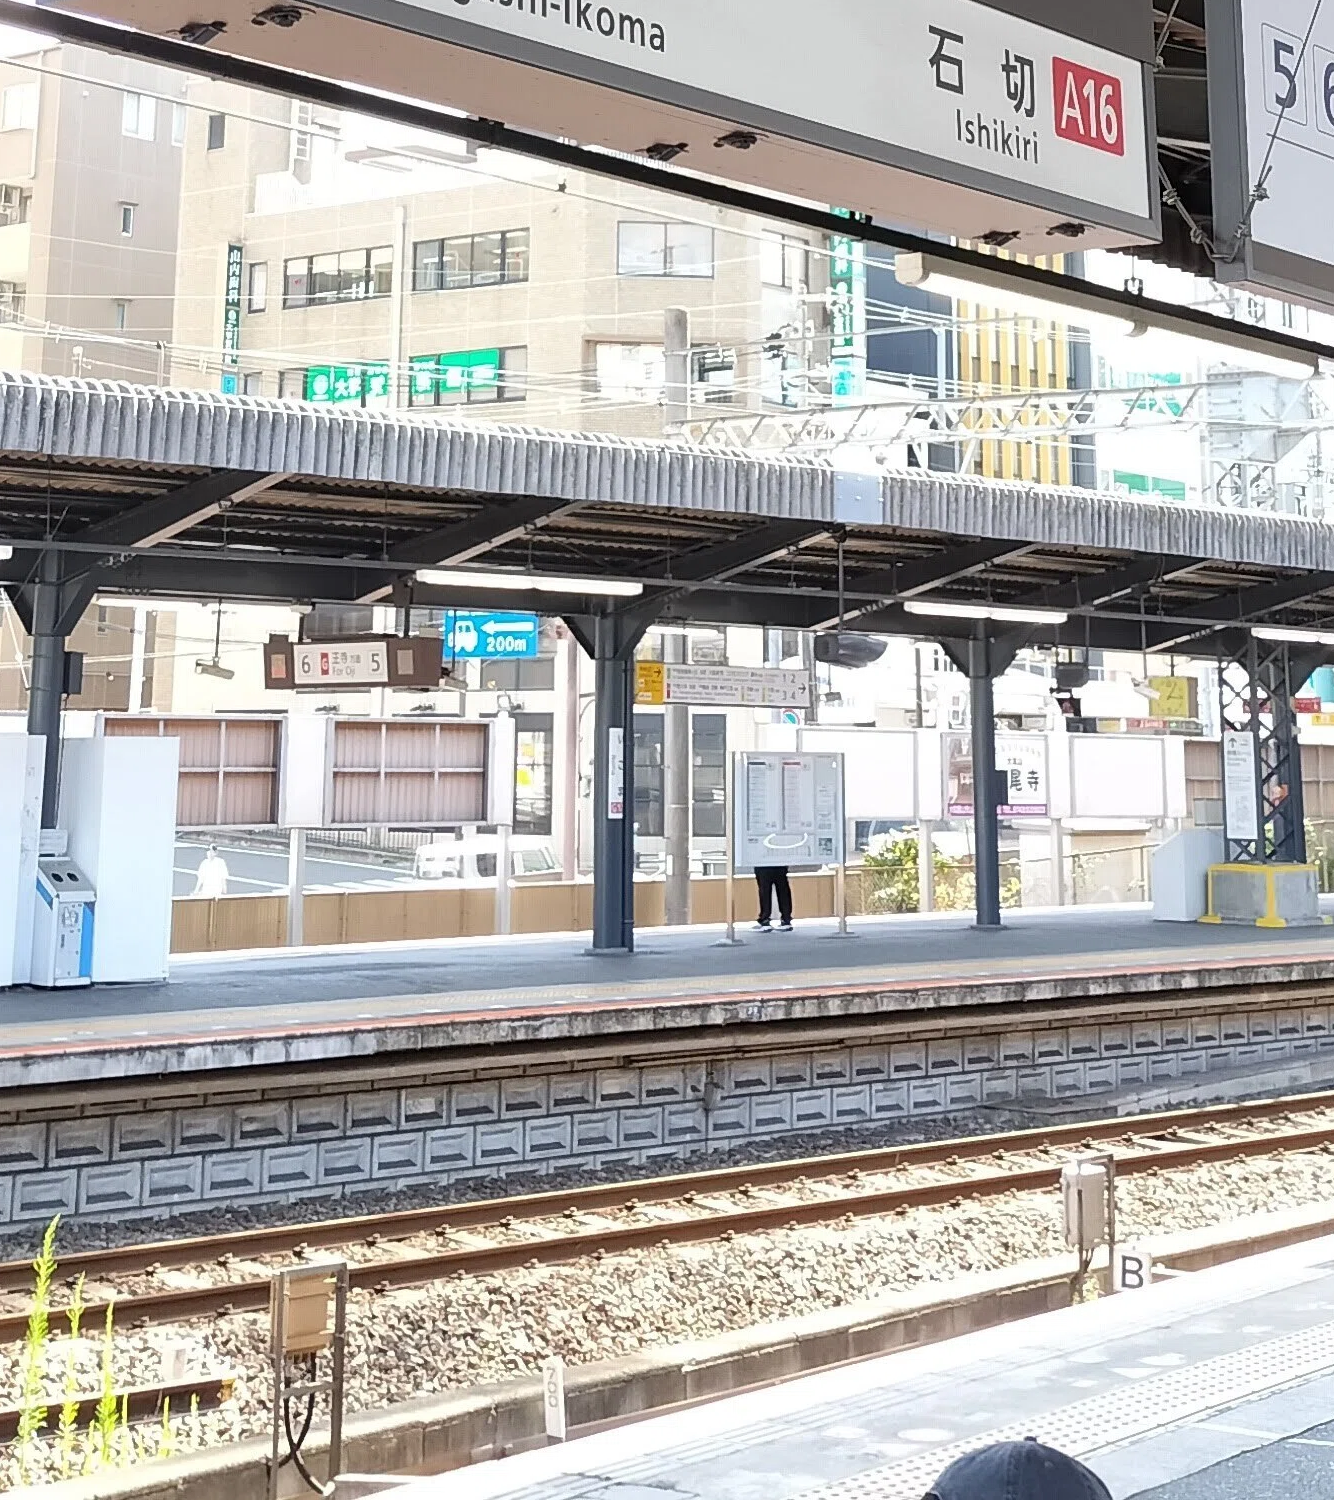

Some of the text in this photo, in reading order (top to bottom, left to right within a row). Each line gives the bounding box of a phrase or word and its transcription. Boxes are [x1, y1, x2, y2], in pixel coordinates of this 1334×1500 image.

[928, 23, 1035, 119] 石切
[1274, 39, 1296, 108] 5
[1061, 67, 1118, 145] A16
[955, 107, 1039, 164] Ishikiri
[301, 654, 311, 673] 6
[370, 653, 381, 672] 5
[486, 636, 527, 652] 200m
[1121, 1255, 1144, 1288] B
